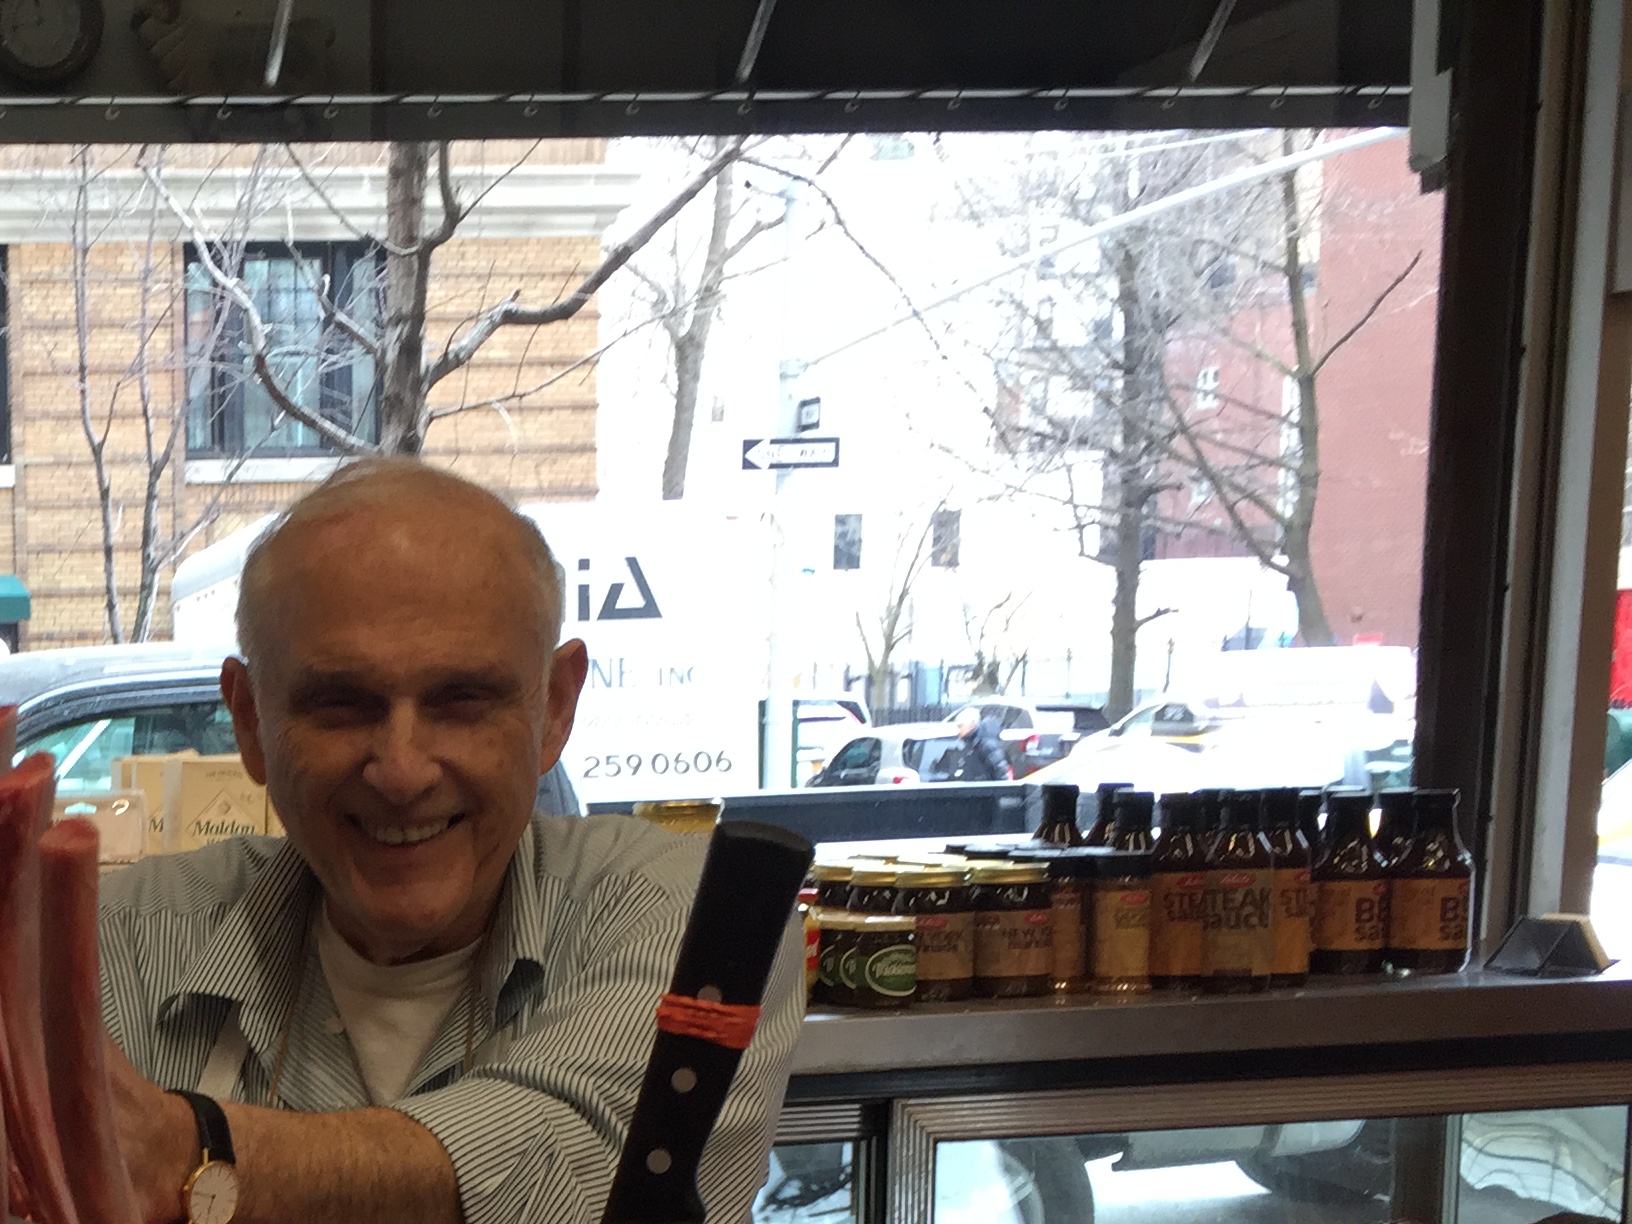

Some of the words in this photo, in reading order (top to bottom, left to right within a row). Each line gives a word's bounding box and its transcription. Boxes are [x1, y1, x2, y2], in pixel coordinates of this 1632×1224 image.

[583, 753, 642, 779] 259
[651, 750, 732, 775] 0606
[191, 819, 256, 837] Maldon
